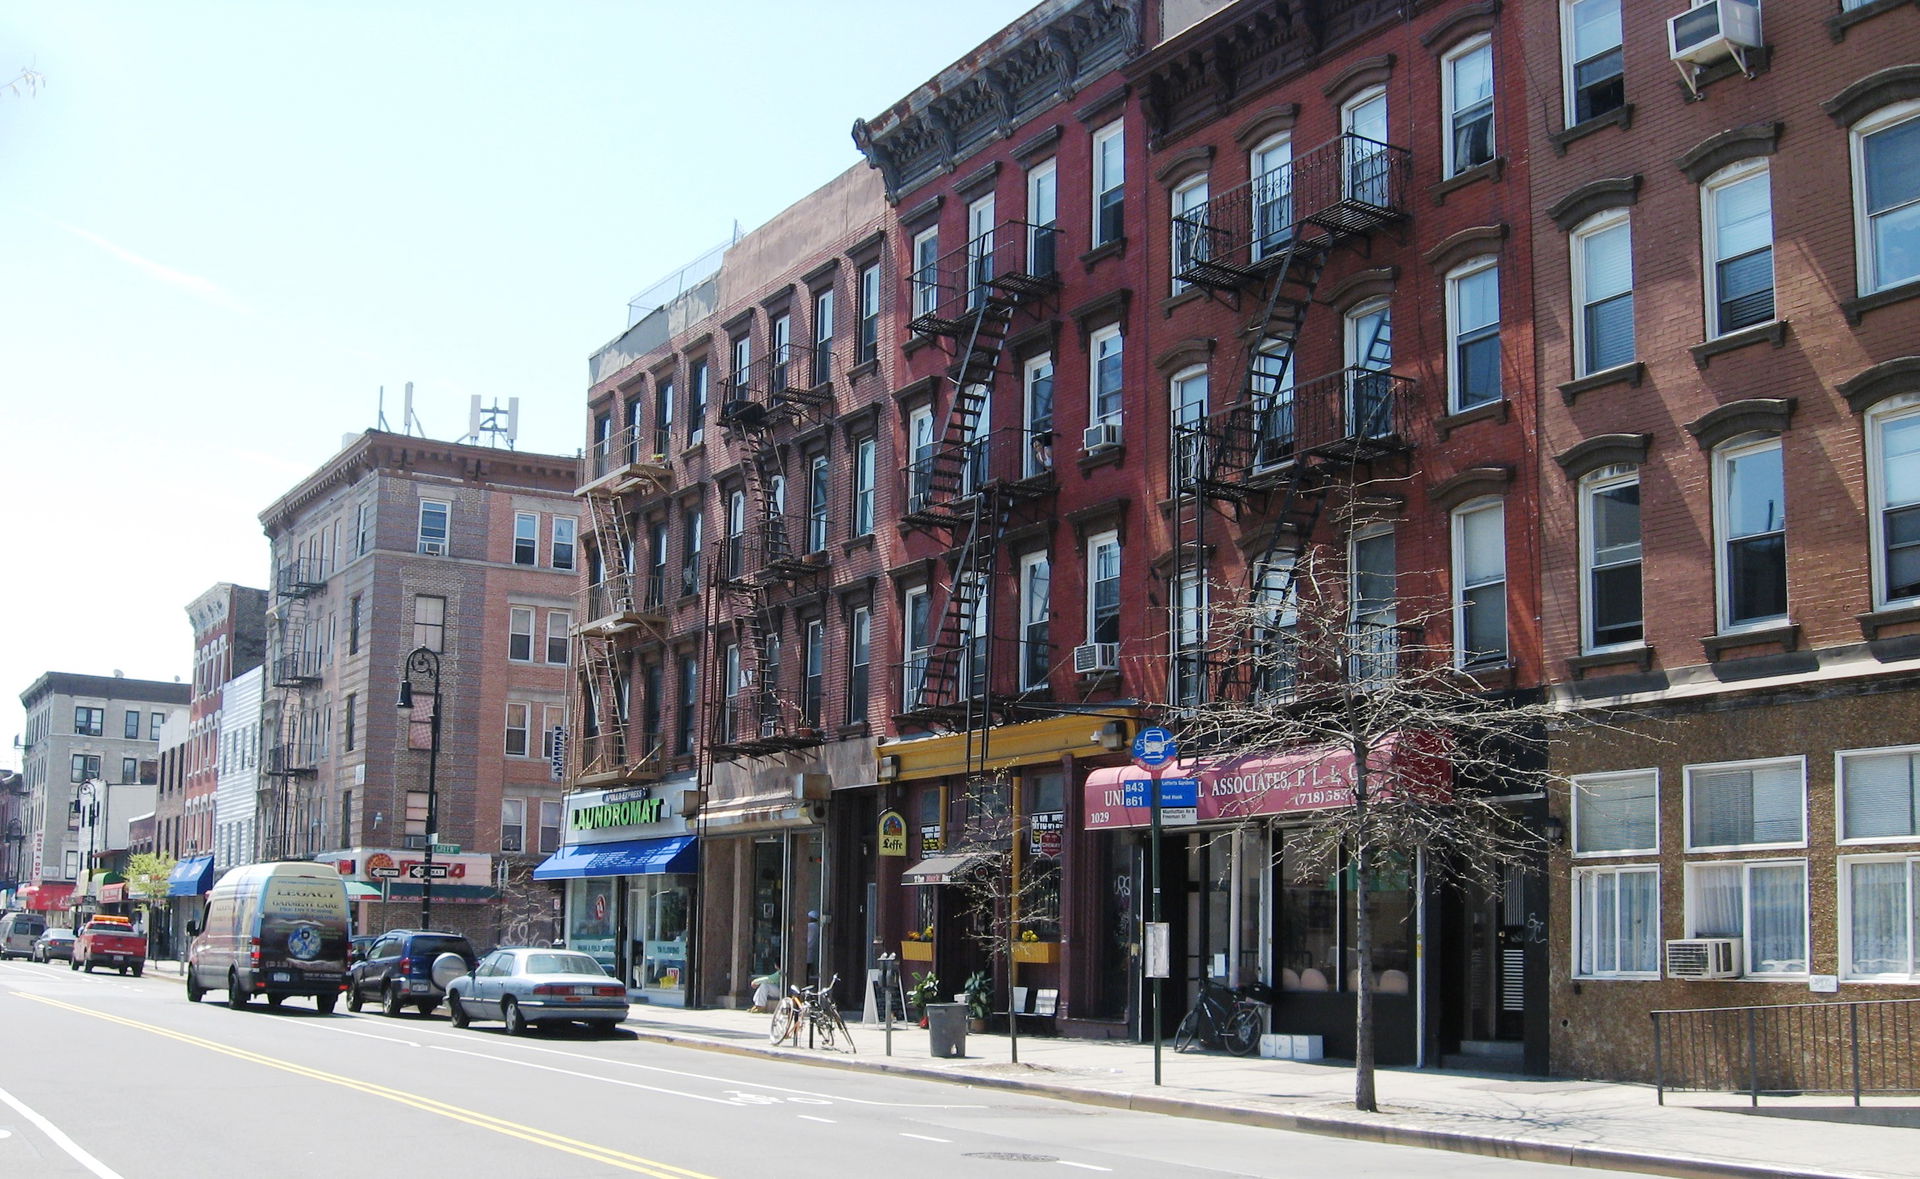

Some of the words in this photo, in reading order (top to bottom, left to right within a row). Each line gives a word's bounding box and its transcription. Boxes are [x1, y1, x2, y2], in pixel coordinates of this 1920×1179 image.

[1125, 782, 1144, 792] B43
[1125, 796, 1143, 806] B61
[1295, 791, 1325, 806] (718)
[571, 798, 661, 831] LAUNDROMAT
[1091, 812, 1110, 824] 1029
[883, 838, 903, 849] Leffe
[277, 889, 336, 898] LEGACY
